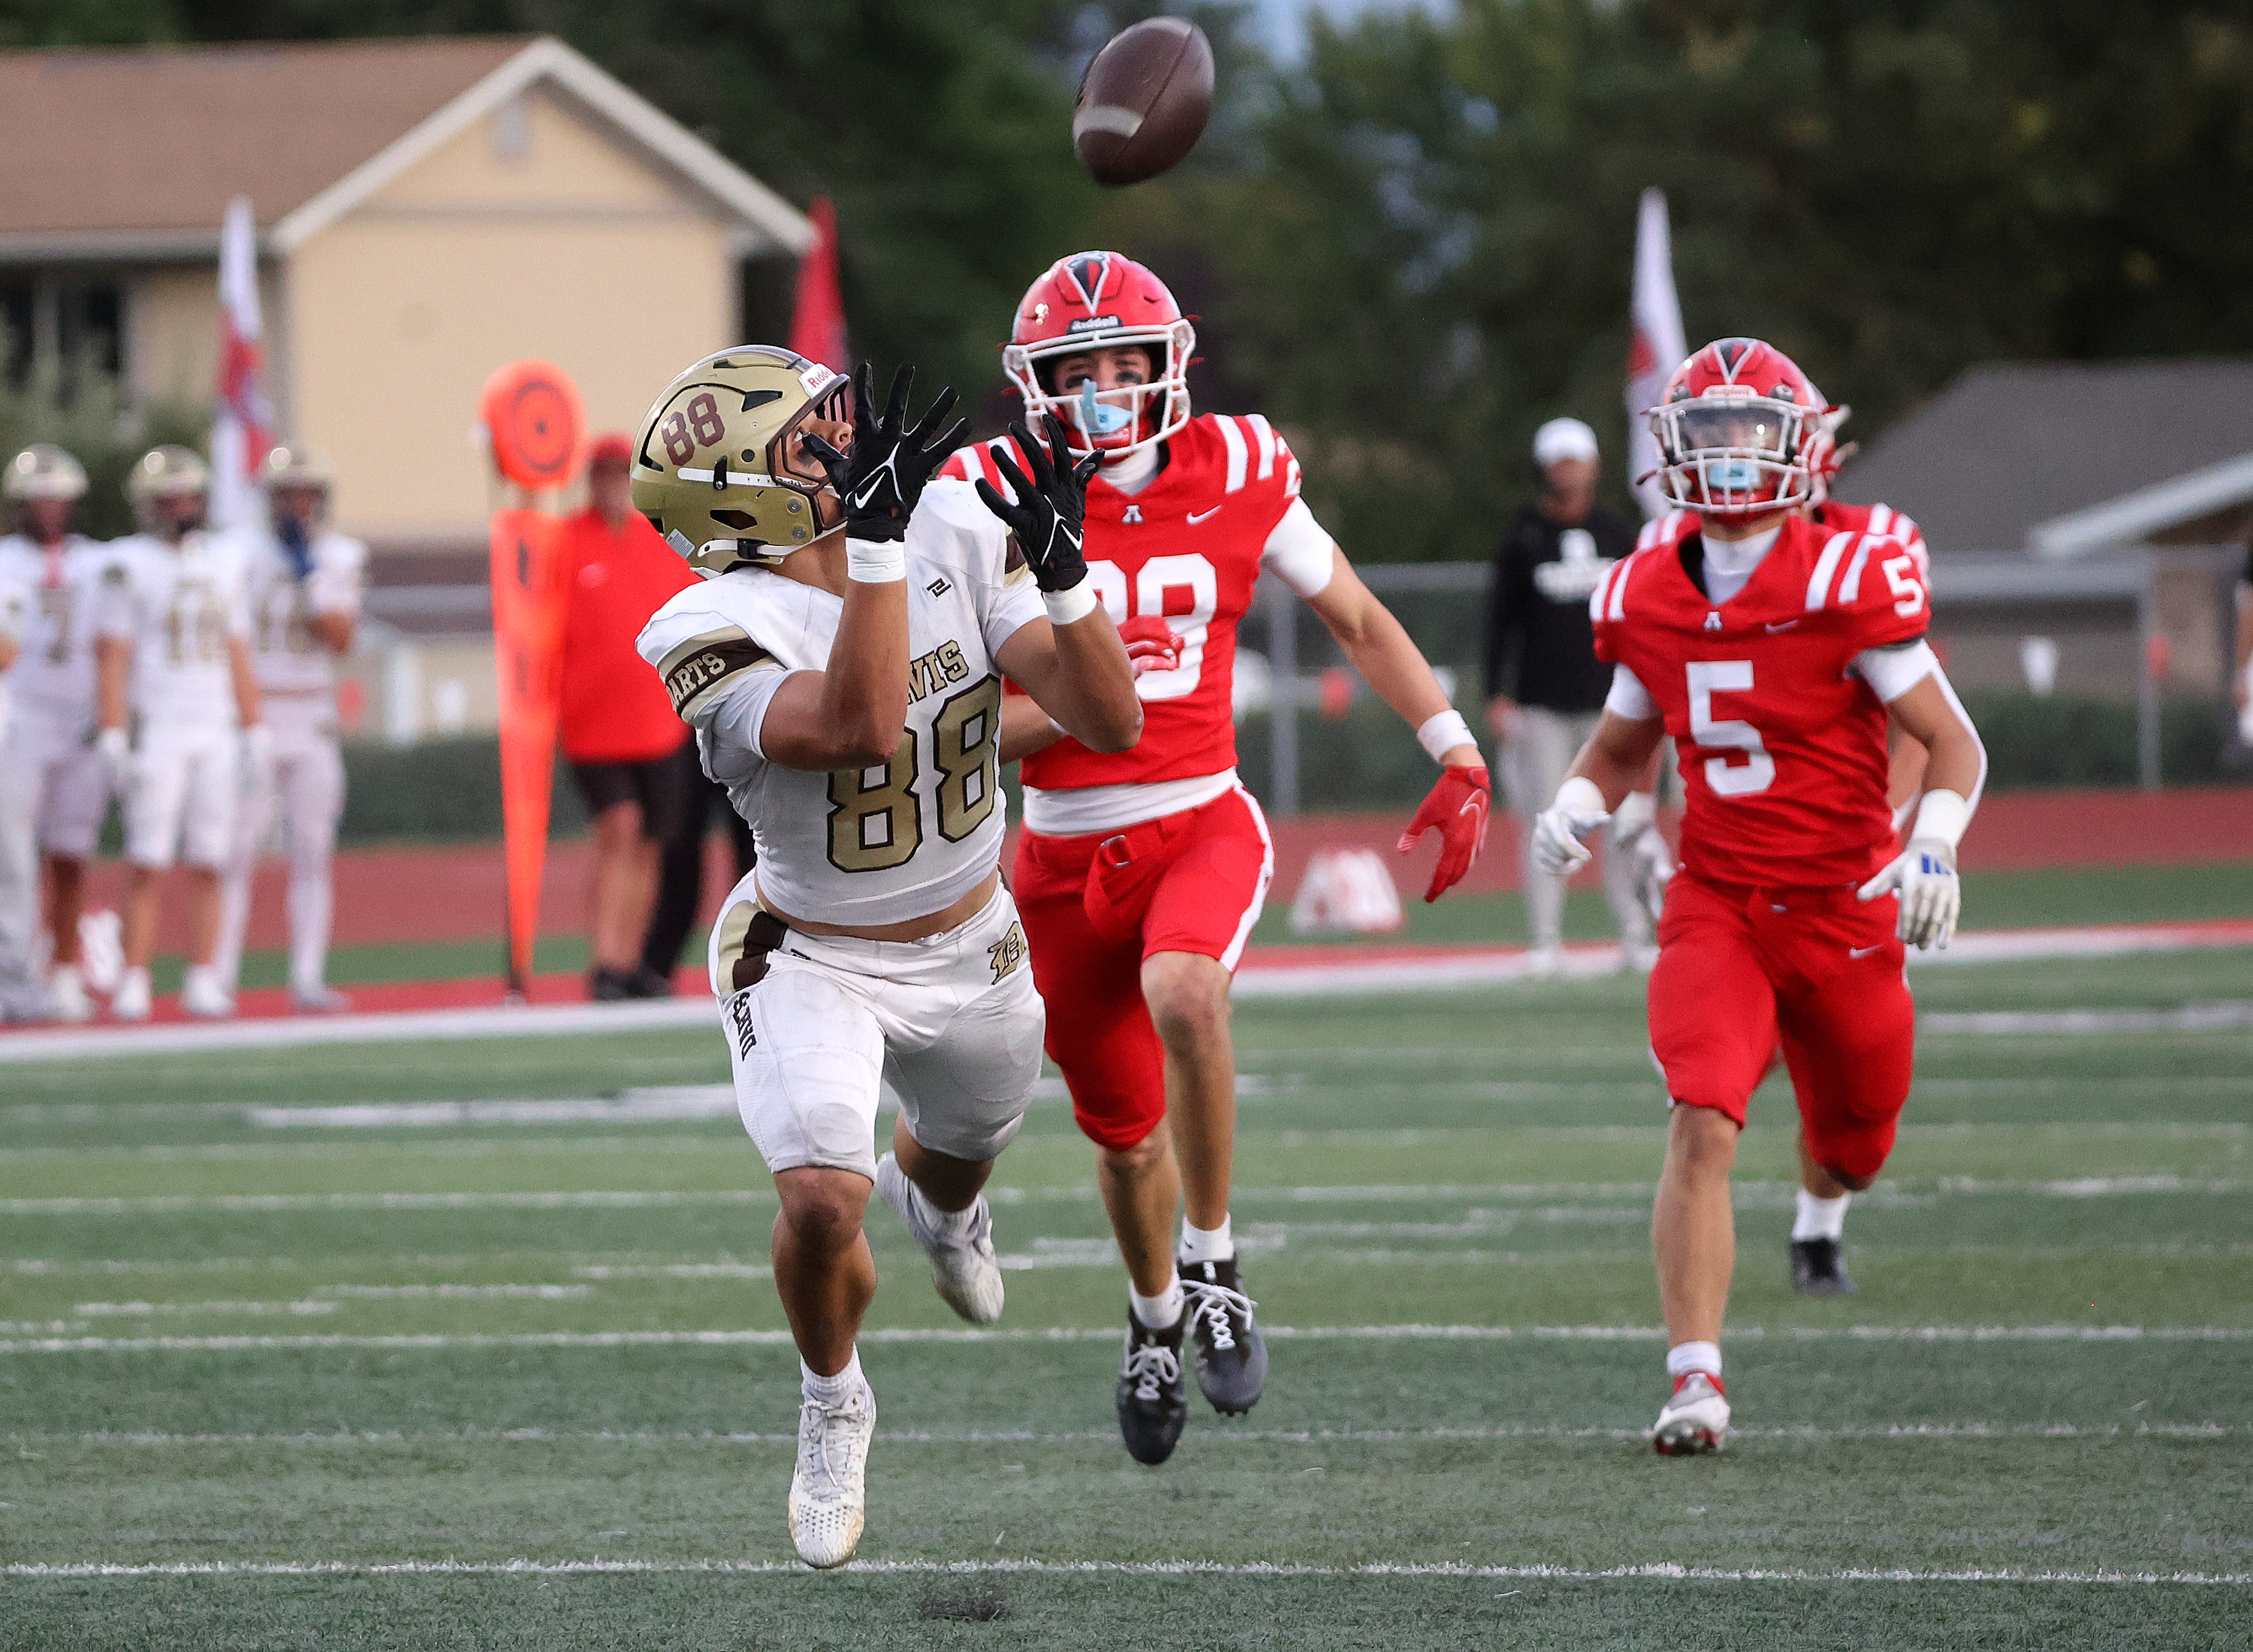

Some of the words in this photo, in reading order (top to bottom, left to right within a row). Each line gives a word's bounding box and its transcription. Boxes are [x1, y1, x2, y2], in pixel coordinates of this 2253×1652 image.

[662, 393, 725, 466] 88
[1881, 554, 1925, 617] 5
[907, 639, 970, 705] VIS
[1686, 659, 1776, 797] 5
[826, 673, 1002, 873] 88
